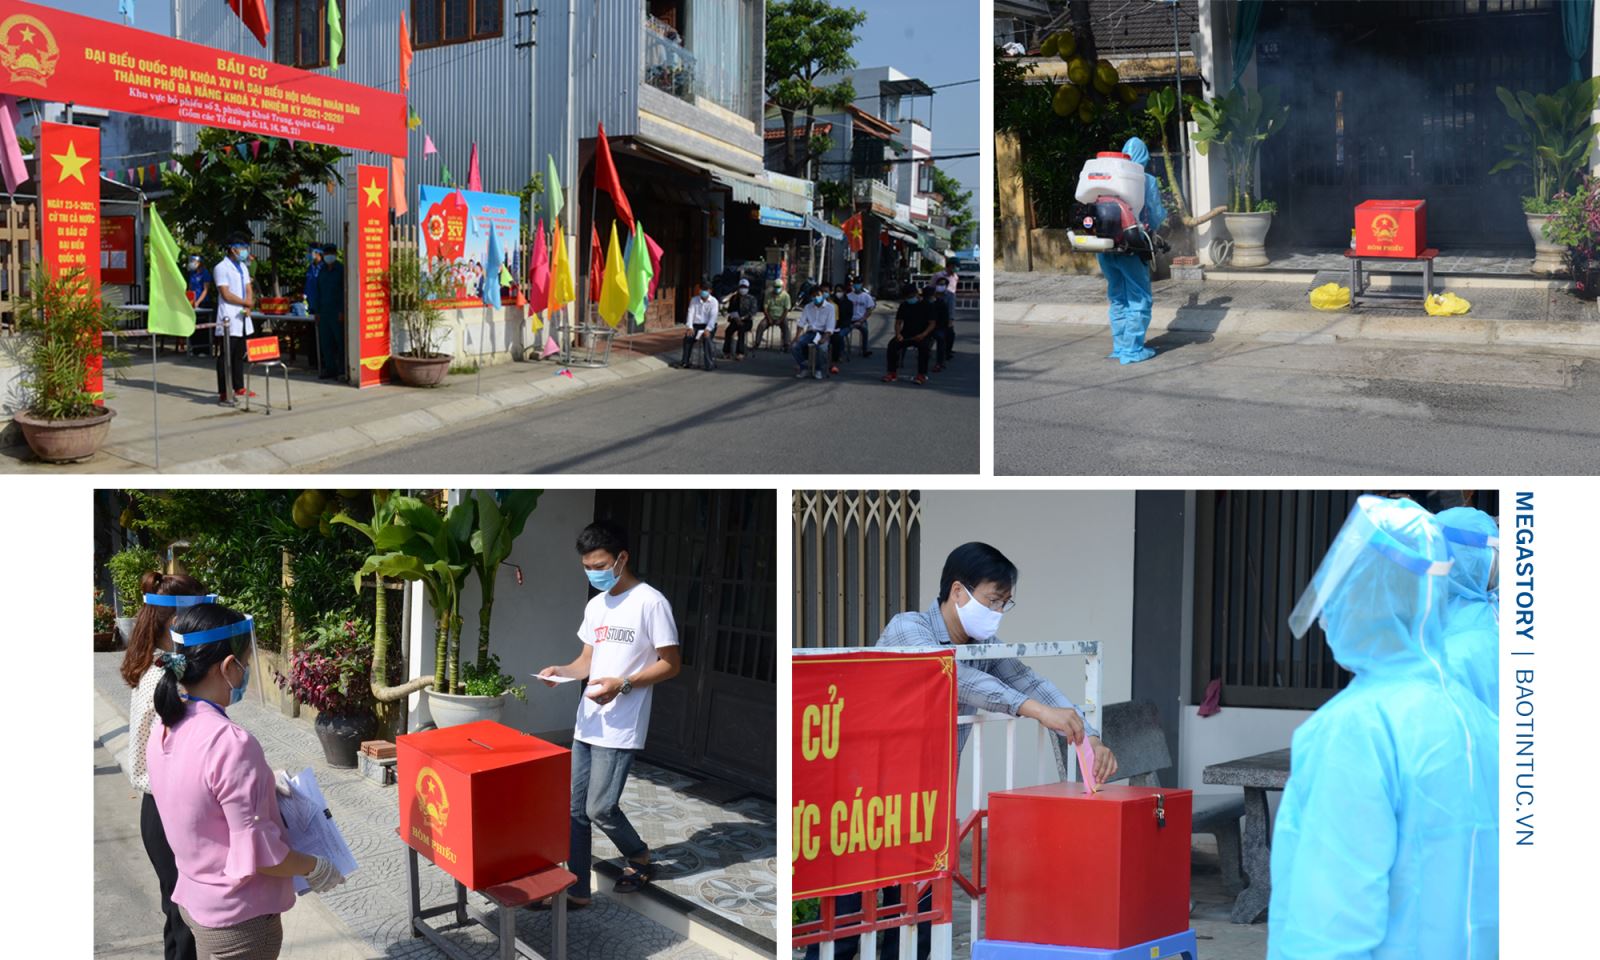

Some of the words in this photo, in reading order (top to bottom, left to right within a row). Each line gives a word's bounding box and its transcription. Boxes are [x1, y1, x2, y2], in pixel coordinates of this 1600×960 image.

[85, 48, 106, 64] ĐẠI
[139, 59, 168, 76] QUỐC
[170, 66, 188, 81] HỘI
[219, 76, 231, 88] XV
[233, 79, 245, 91] VÀ
[247, 83, 262, 96] ĐẠI
[249, 64, 268, 80] CỬ
[113, 69, 151, 88] THÀNH
[154, 77, 176, 92] PHỐ
[178, 82, 192, 95] ĐÀ
[261, 98, 289, 114] NHIỆM
[129, 87, 148, 99] Khu
[150, 92, 166, 103] vực
[179, 97, 202, 109] phiếu
[204, 101, 214, 110] số
[47, 198, 64, 209] NGÀY
[447, 225, 464, 237] XV
[607, 628, 635, 643] STUDIOS
[801, 684, 844, 761] CỬ
[830, 786, 902, 857] CÁCH
[910, 790, 938, 844] LY
[412, 826, 430, 846] HÒM
[431, 839, 457, 864] PHIẾU
